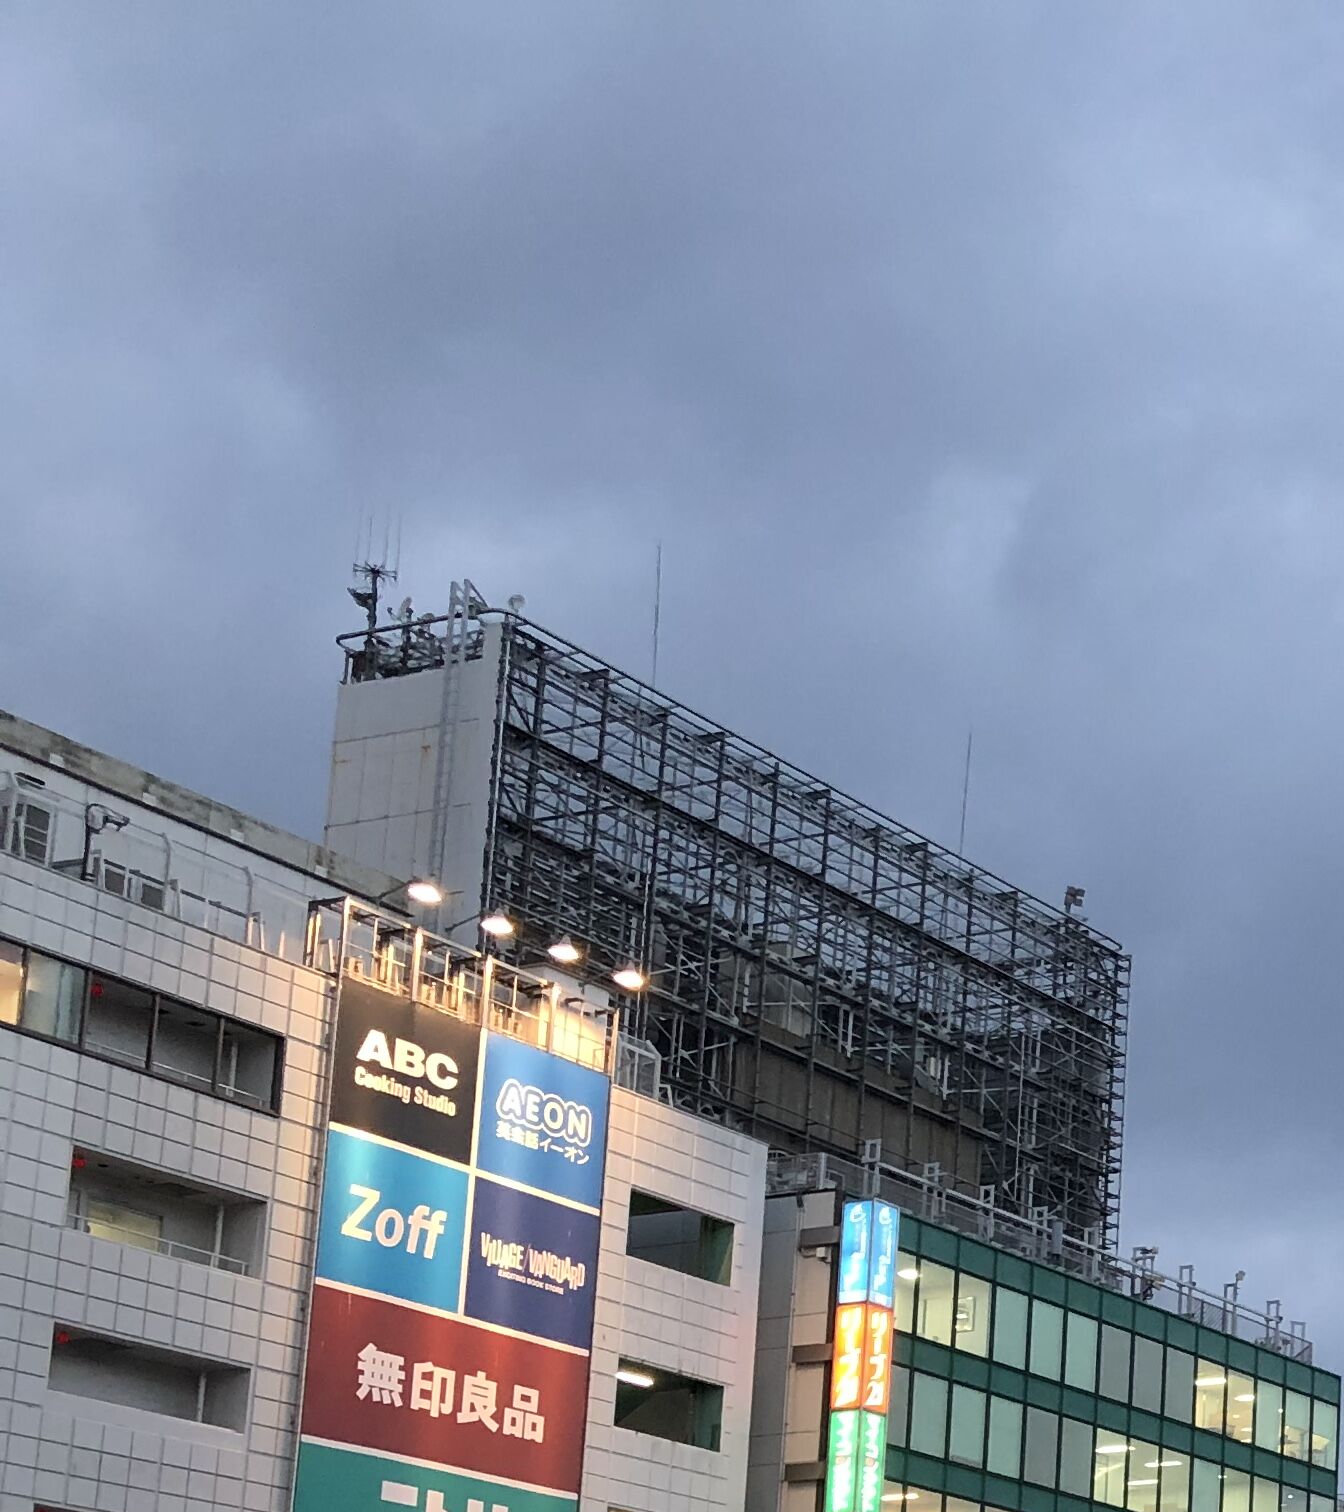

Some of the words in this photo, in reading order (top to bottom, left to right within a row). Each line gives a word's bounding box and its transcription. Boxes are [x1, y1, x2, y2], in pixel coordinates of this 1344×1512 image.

[354, 1065, 411, 1105] Cooking
[414, 1085, 456, 1117] Studio
[356, 1029, 458, 1090] ABC
[497, 1079, 592, 1147] AEON
[341, 1184, 448, 1259] Zoff
[356, 1342, 546, 1444] 無印良品
